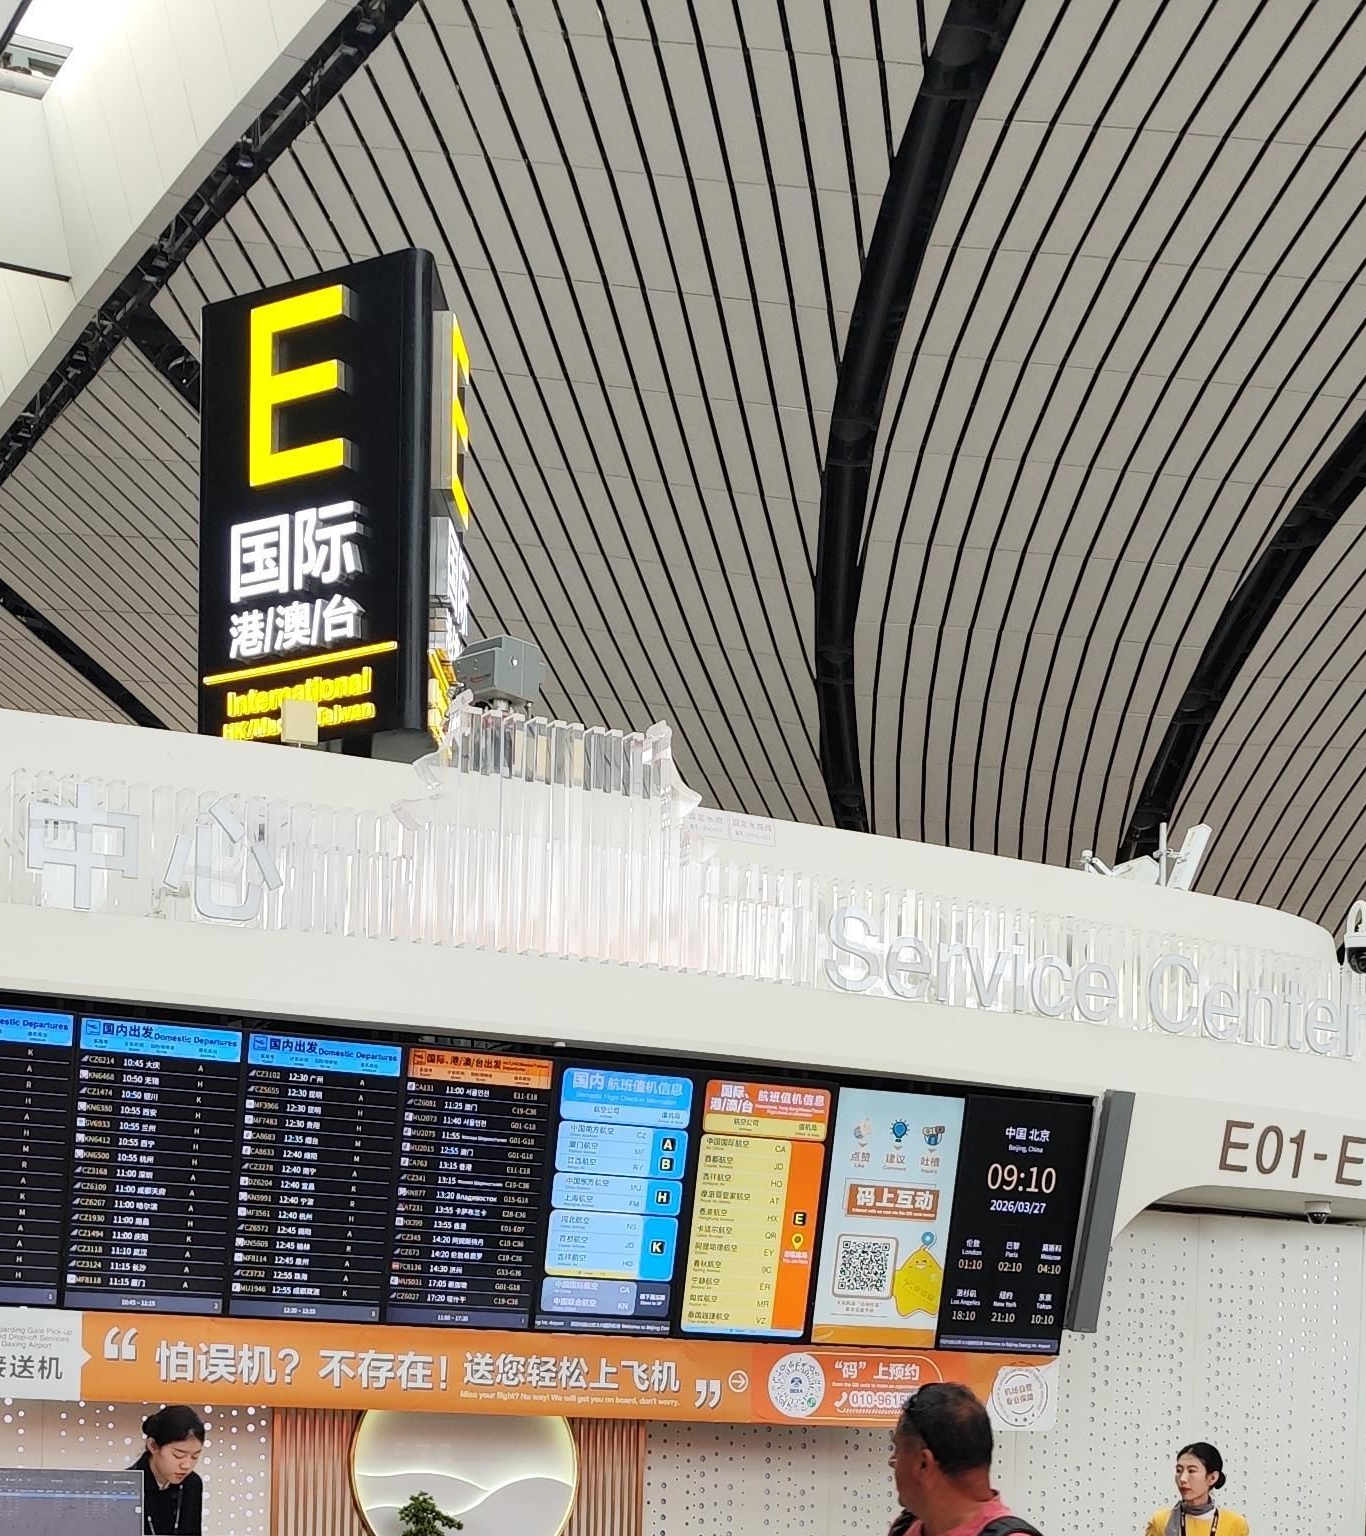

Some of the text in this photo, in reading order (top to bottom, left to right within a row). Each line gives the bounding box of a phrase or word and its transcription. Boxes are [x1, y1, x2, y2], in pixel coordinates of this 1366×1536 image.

[250, 285, 352, 486] E
[231, 501, 361, 603] 国际
[230, 594, 360, 659] 港/澳/台
[227, 667, 372, 717] International
[823, 906, 1119, 1022] Service
[23, 1019, 68, 1031] Departures
[103, 1023, 237, 1047] 国内出发 Domestic Departures
[270, 1038, 397, 1062] 国内出发 Domestic Departures
[123, 1059, 143, 1068] 10:45
[289, 1073, 308, 1082] 12:30
[573, 1072, 683, 1096] 国内 航班值机信息
[446, 1086, 464, 1094] 11:00
[758, 1090, 824, 1106] 航班值机信息
[444, 1102, 463, 1110] 11:25
[710, 1098, 753, 1113] 港/澳/台
[120, 1122, 139, 1130] 10:55
[284, 1135, 303, 1143] 12:35
[1006, 1126, 1050, 1142] 中国 北京
[663, 1140, 673, 1150] A
[851, 1152, 870, 1162] 点赞
[885, 1154, 905, 1164] 建议
[661, 1160, 671, 1170] B
[987, 1163, 1056, 1194] 09:10
[115, 1185, 135, 1193] 11:00
[657, 1193, 667, 1202] H
[857, 1187, 934, 1210] 码上互动
[990, 1200, 1046, 1215] 2026/03/27
[795, 1214, 804, 1224] E
[653, 1242, 662, 1252] K
[110, 1262, 130, 1270] 11:15
[958, 1259, 983, 1270] 01:10
[998, 1261, 1022, 1272] 02:10
[1037, 1264, 1061, 1274] 04:10
[272, 1286, 291, 1294] 12:55
[952, 1311, 976, 1321] 18:10
[991, 1312, 1015, 1323] 21:10
[1031, 1314, 1054, 1324] 10:10
[873, 1362, 920, 1380] 上预约
[532, 1393, 550, 1402] way!
